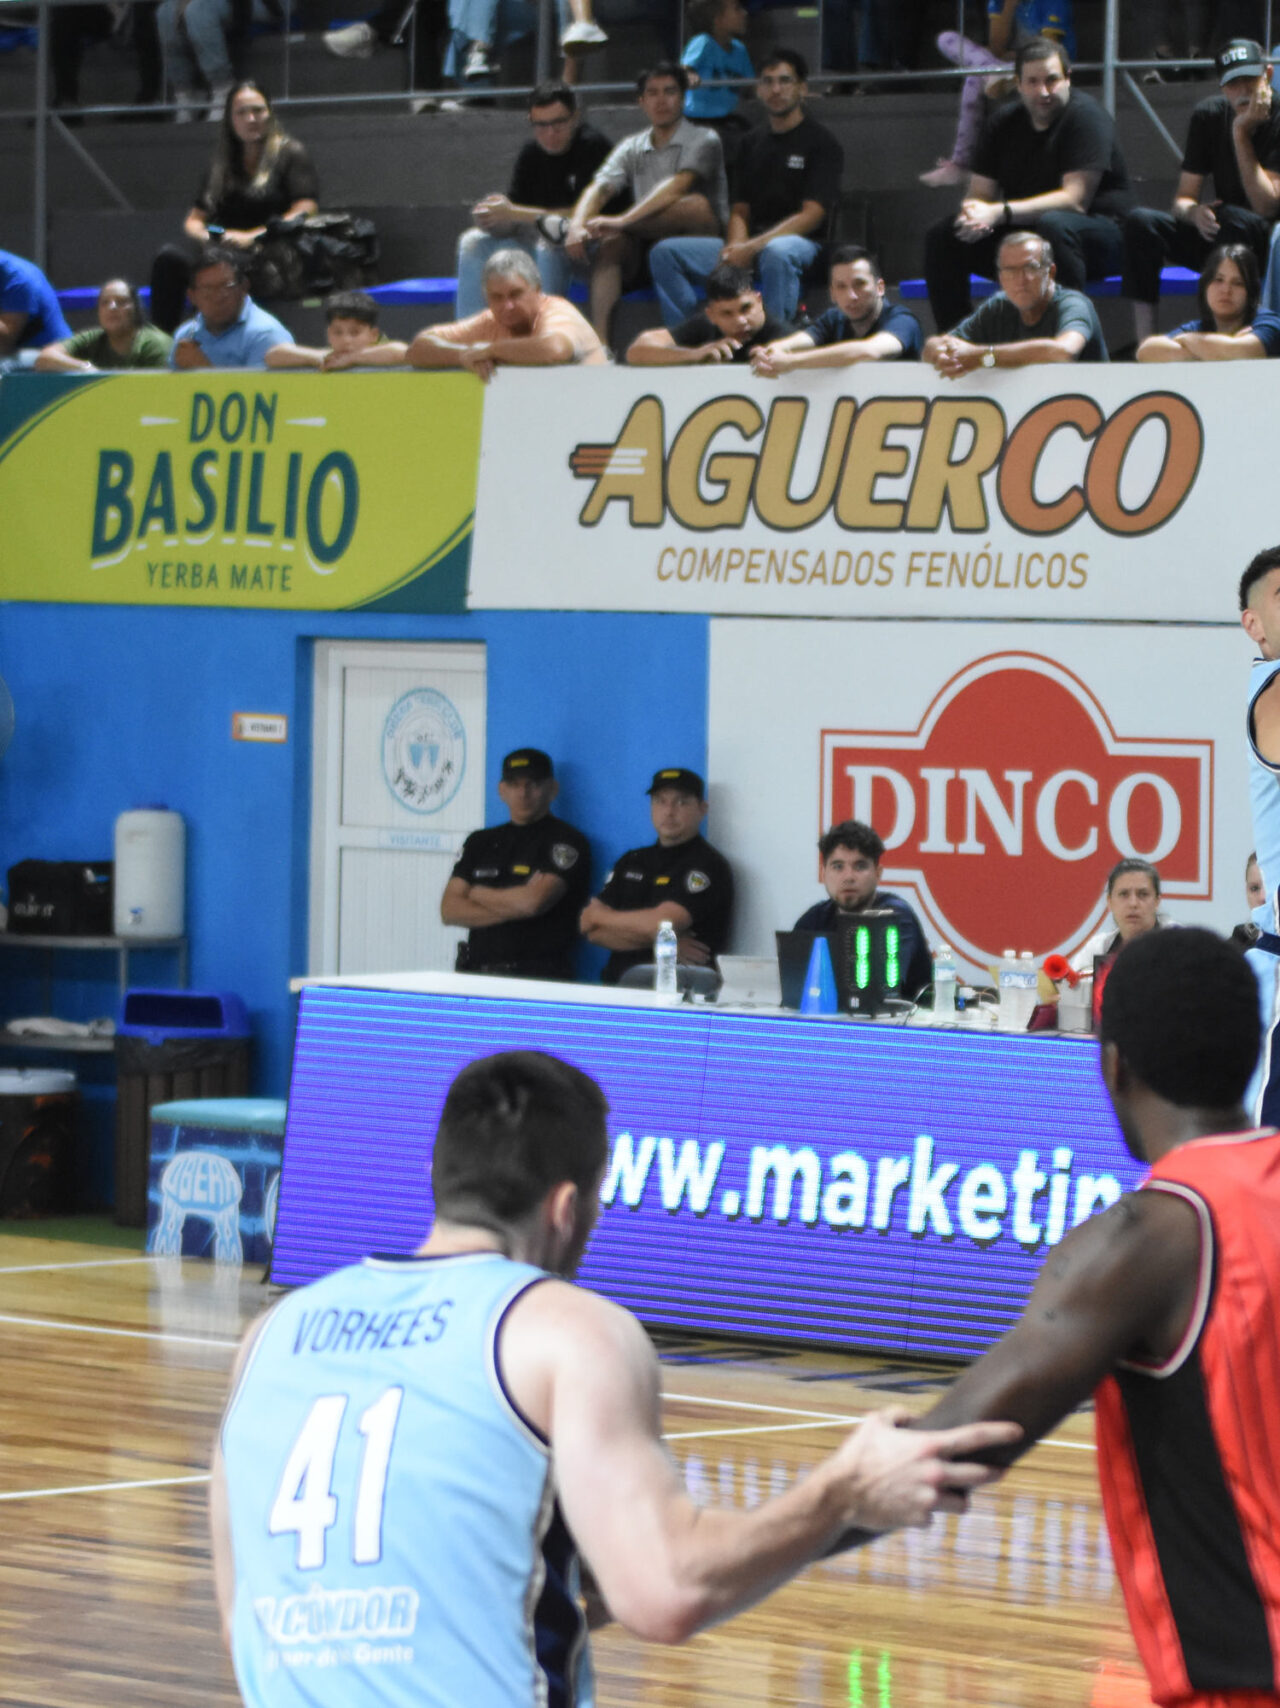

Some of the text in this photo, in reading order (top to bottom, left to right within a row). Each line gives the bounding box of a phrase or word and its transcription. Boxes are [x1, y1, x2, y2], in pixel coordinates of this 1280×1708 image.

[190, 391, 277, 443] DON
[570, 391, 1204, 537] AGUERCO
[91, 449, 360, 564] BASILIO
[147, 562, 293, 591] YERBA MATE
[657, 542, 1089, 588] COMPENSADOS FENÓLICOS
[845, 765, 1182, 863] DINCO
[293, 1299, 455, 1355] VORHEES
[269, 1383, 405, 1572] 41
